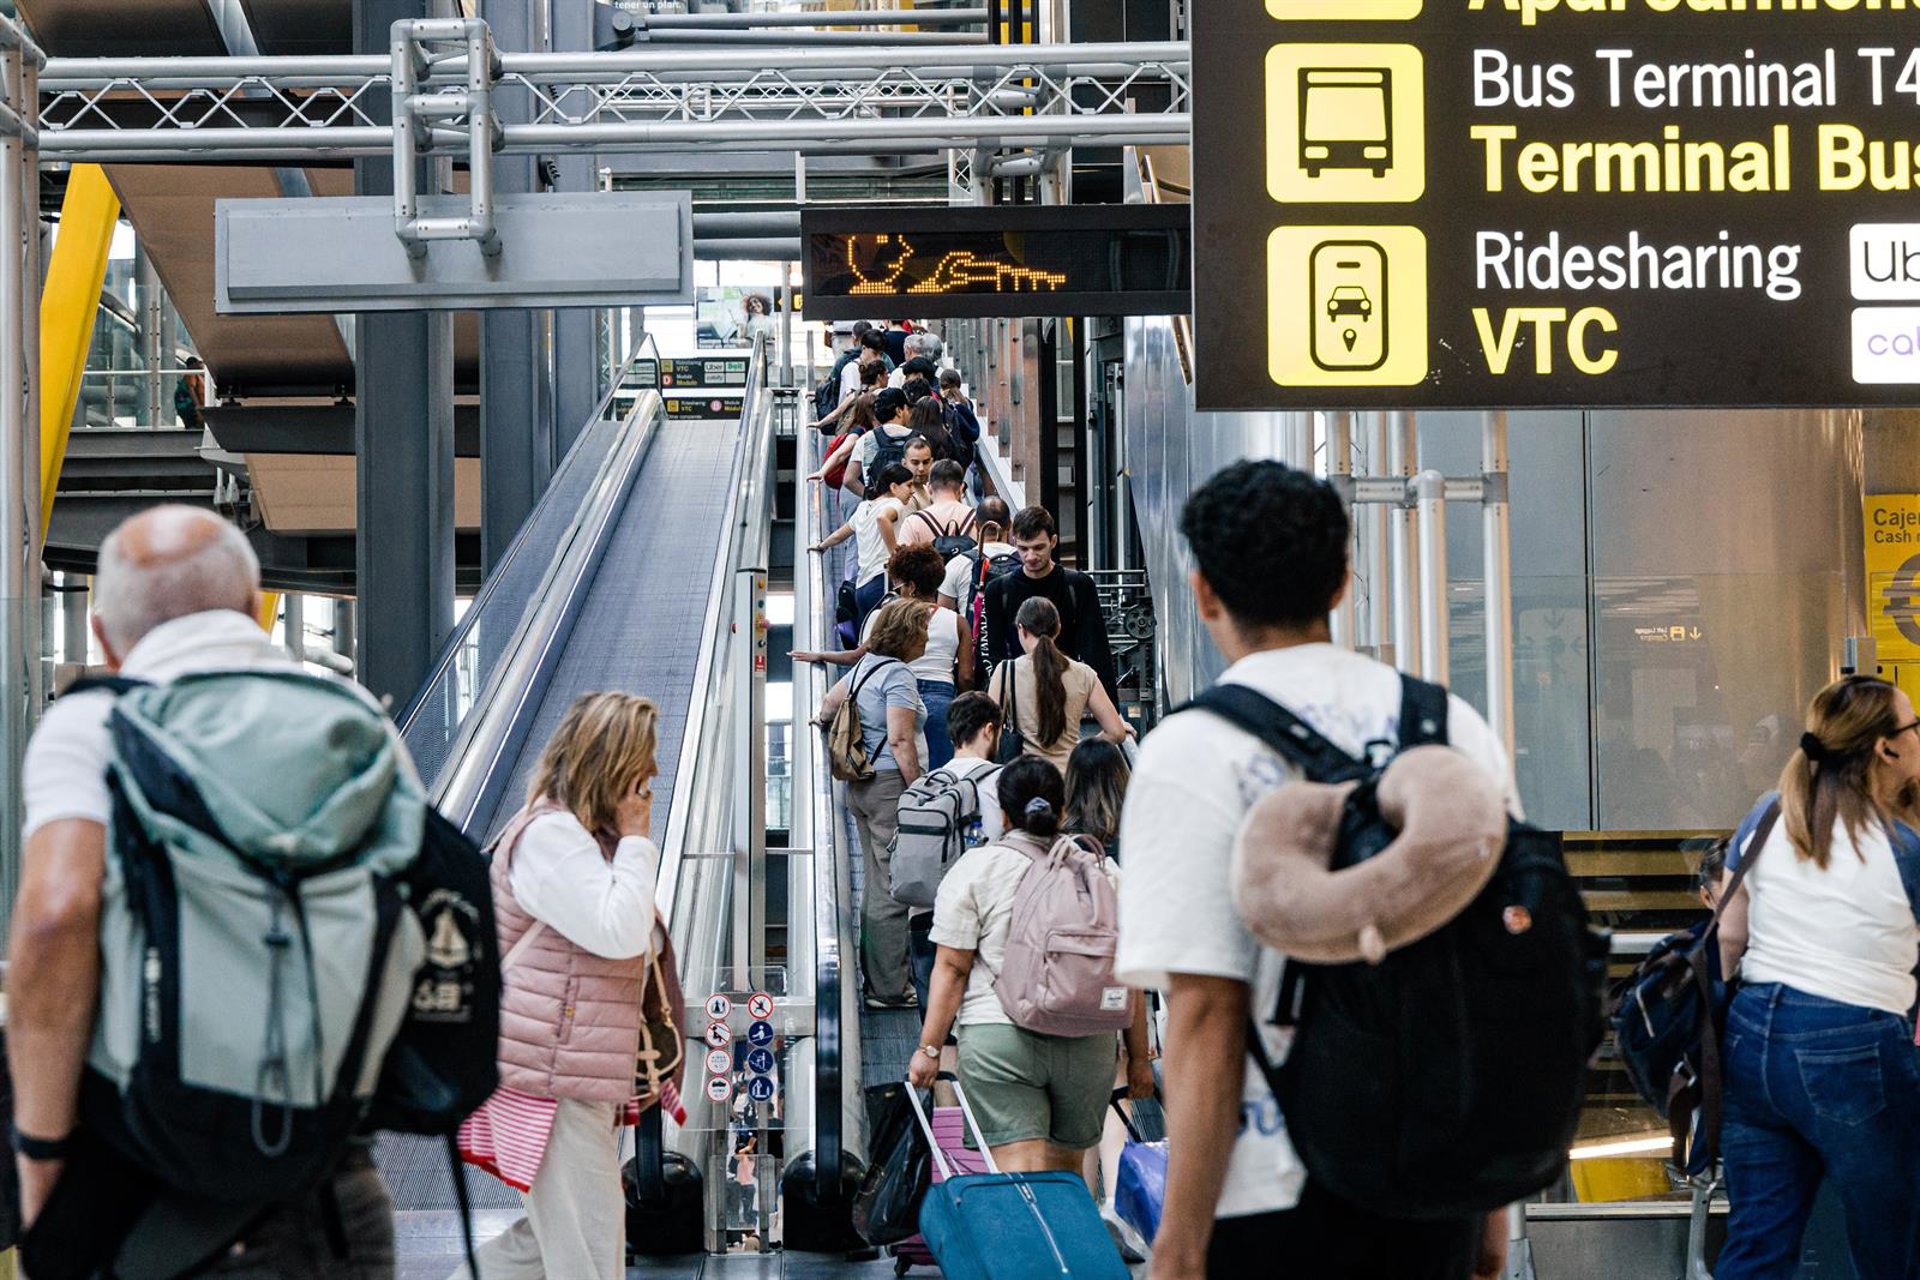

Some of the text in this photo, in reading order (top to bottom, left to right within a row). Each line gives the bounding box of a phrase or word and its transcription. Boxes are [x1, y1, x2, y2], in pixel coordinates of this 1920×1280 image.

[1473, 48, 1575, 109] Bus
[1595, 47, 1836, 109] Terminal
[1469, 124, 1920, 192] Terminal Bu
[1475, 230, 1802, 301] Ridesharing
[1471, 306, 1619, 375] VTC
[1867, 325, 1920, 357] ca
[663, 375, 670, 385] D
[1873, 508, 1920, 529] Caje
[1873, 530, 1912, 544] Cash
